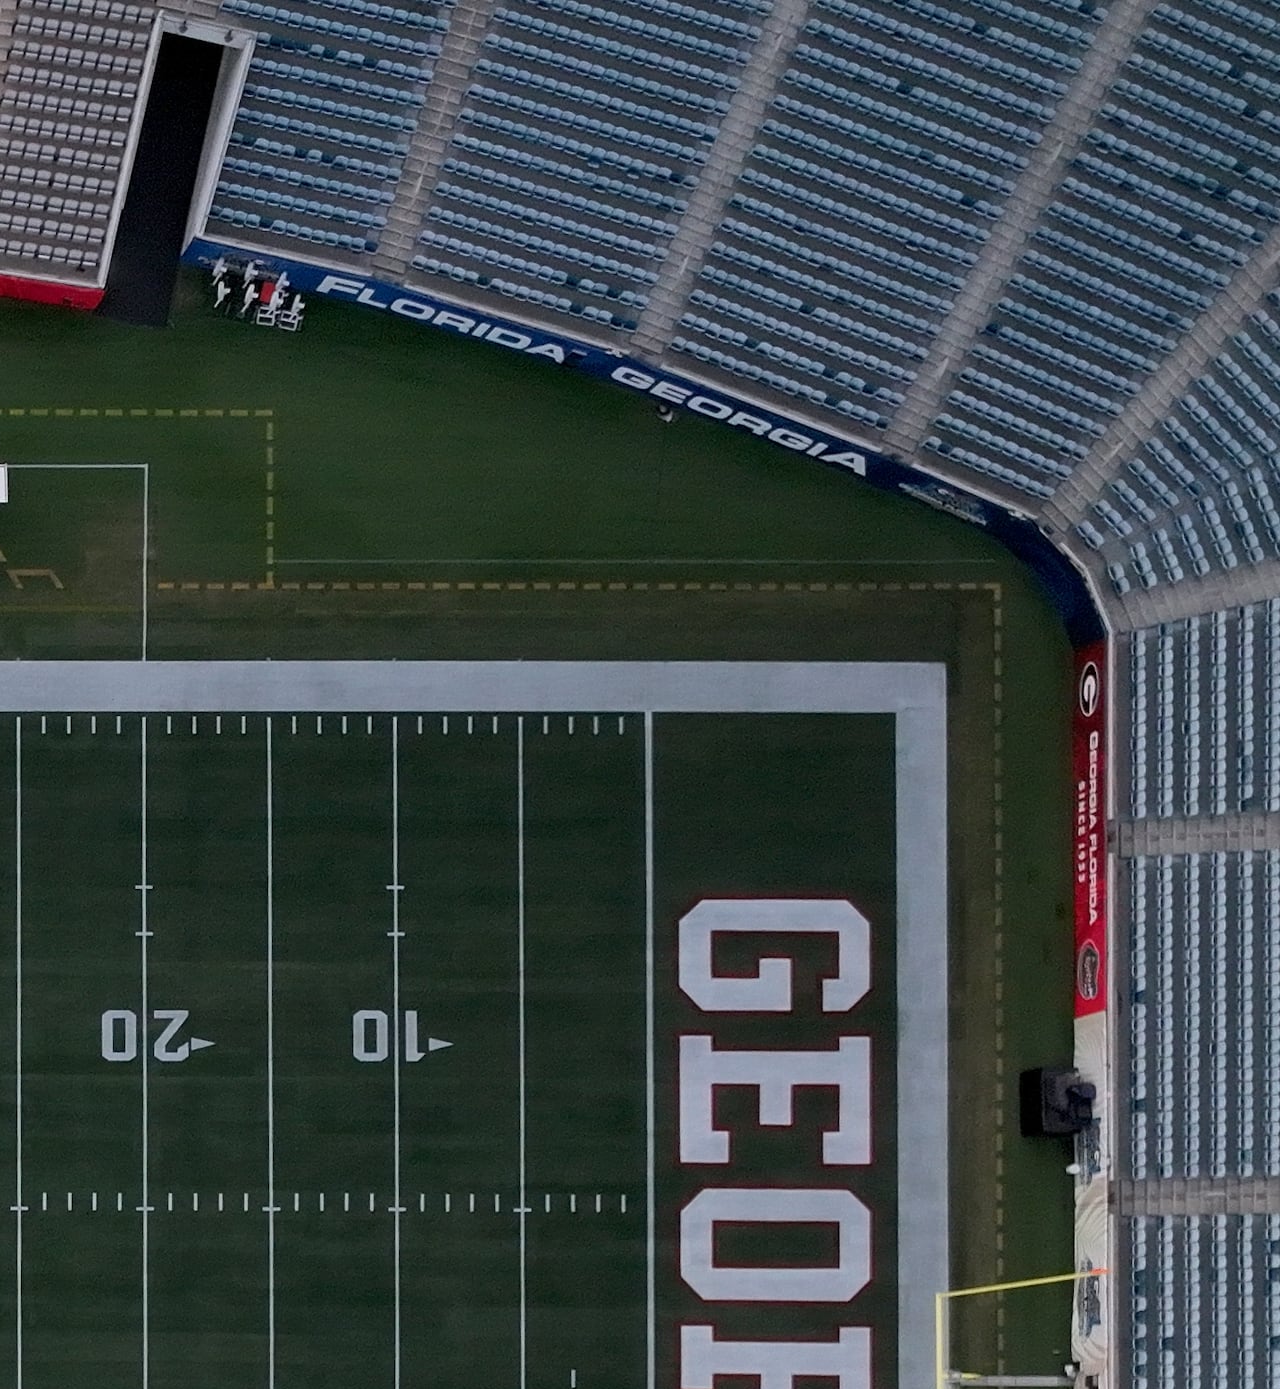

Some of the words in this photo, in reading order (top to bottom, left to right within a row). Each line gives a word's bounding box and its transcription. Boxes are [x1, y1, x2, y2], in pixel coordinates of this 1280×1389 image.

[316, 274, 566, 365] FLORIDA
[610, 365, 867, 477] GEORGIA
[1078, 780, 1086, 836] SINCE
[1088, 731, 1099, 830] GEORGIA
[1088, 833, 1099, 926] FLORIDA
[102, 1010, 189, 1062] 20
[353, 1010, 426, 1062] 10
